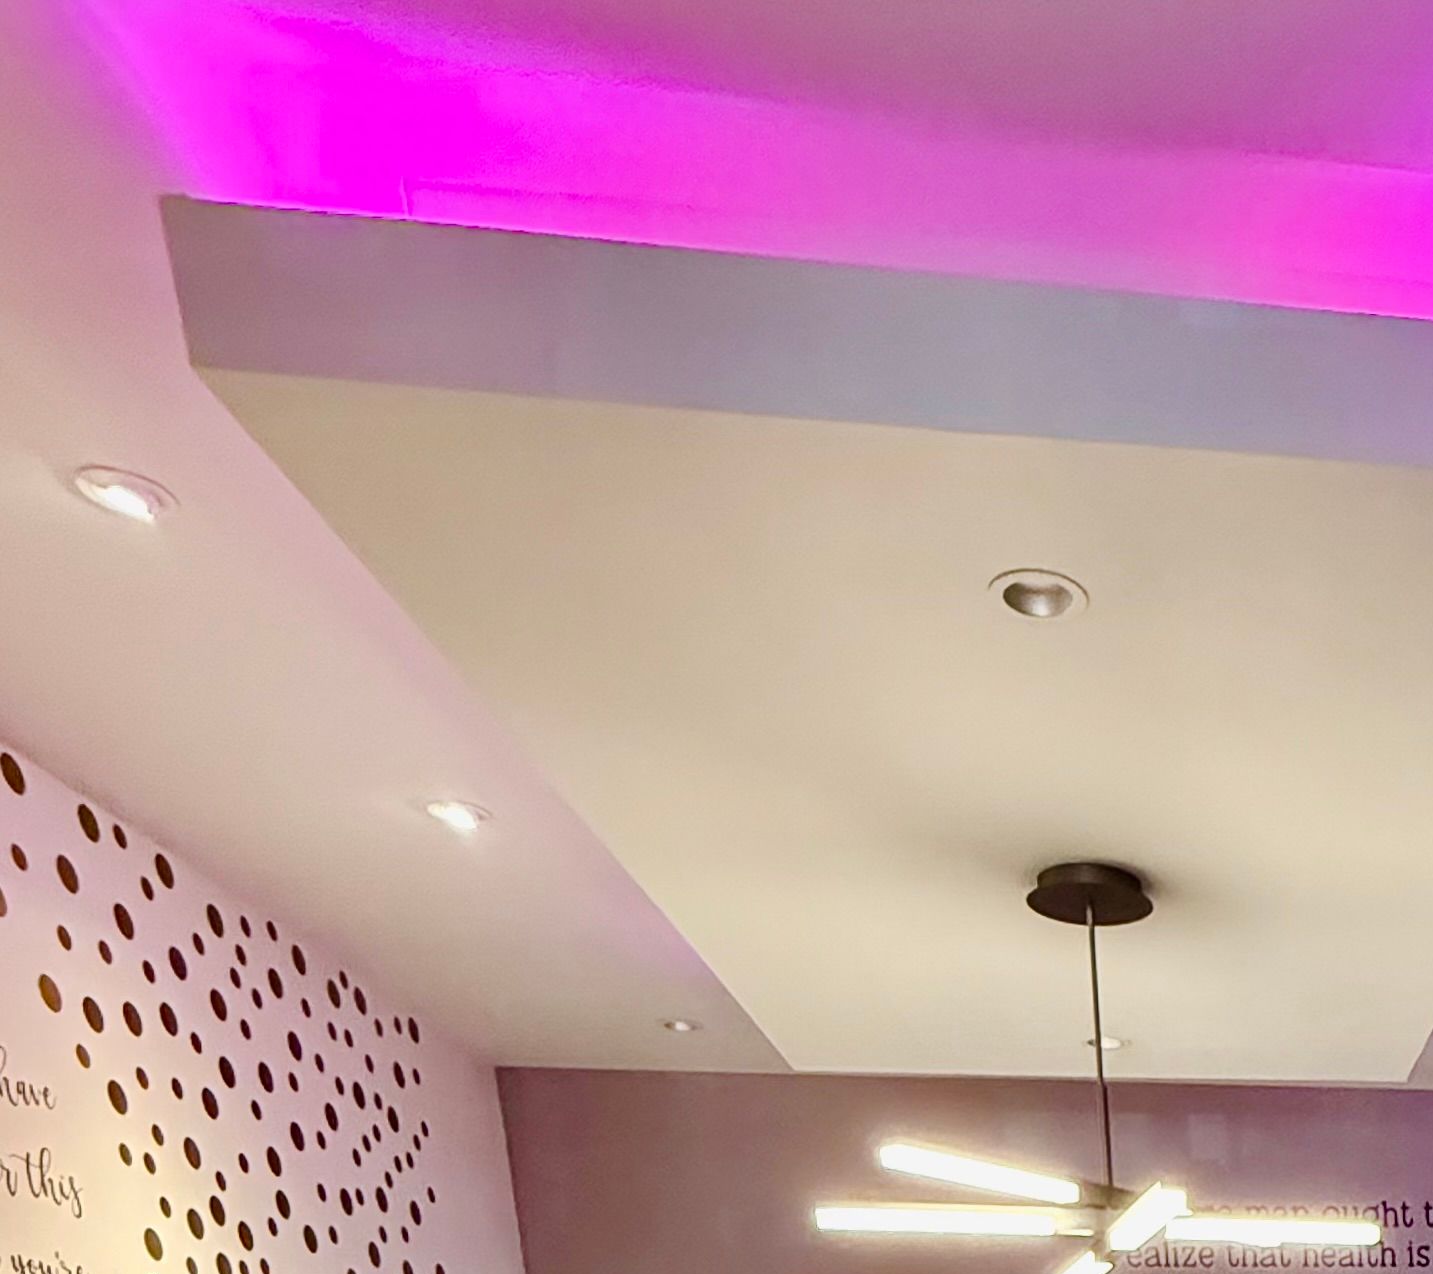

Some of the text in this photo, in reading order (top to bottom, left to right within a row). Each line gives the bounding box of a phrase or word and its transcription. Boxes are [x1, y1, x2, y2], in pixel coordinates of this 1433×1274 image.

[9, 1147, 84, 1219] this
[1126, 1247, 1215, 1269] ealize
[1407, 1240, 1431, 1268] is
